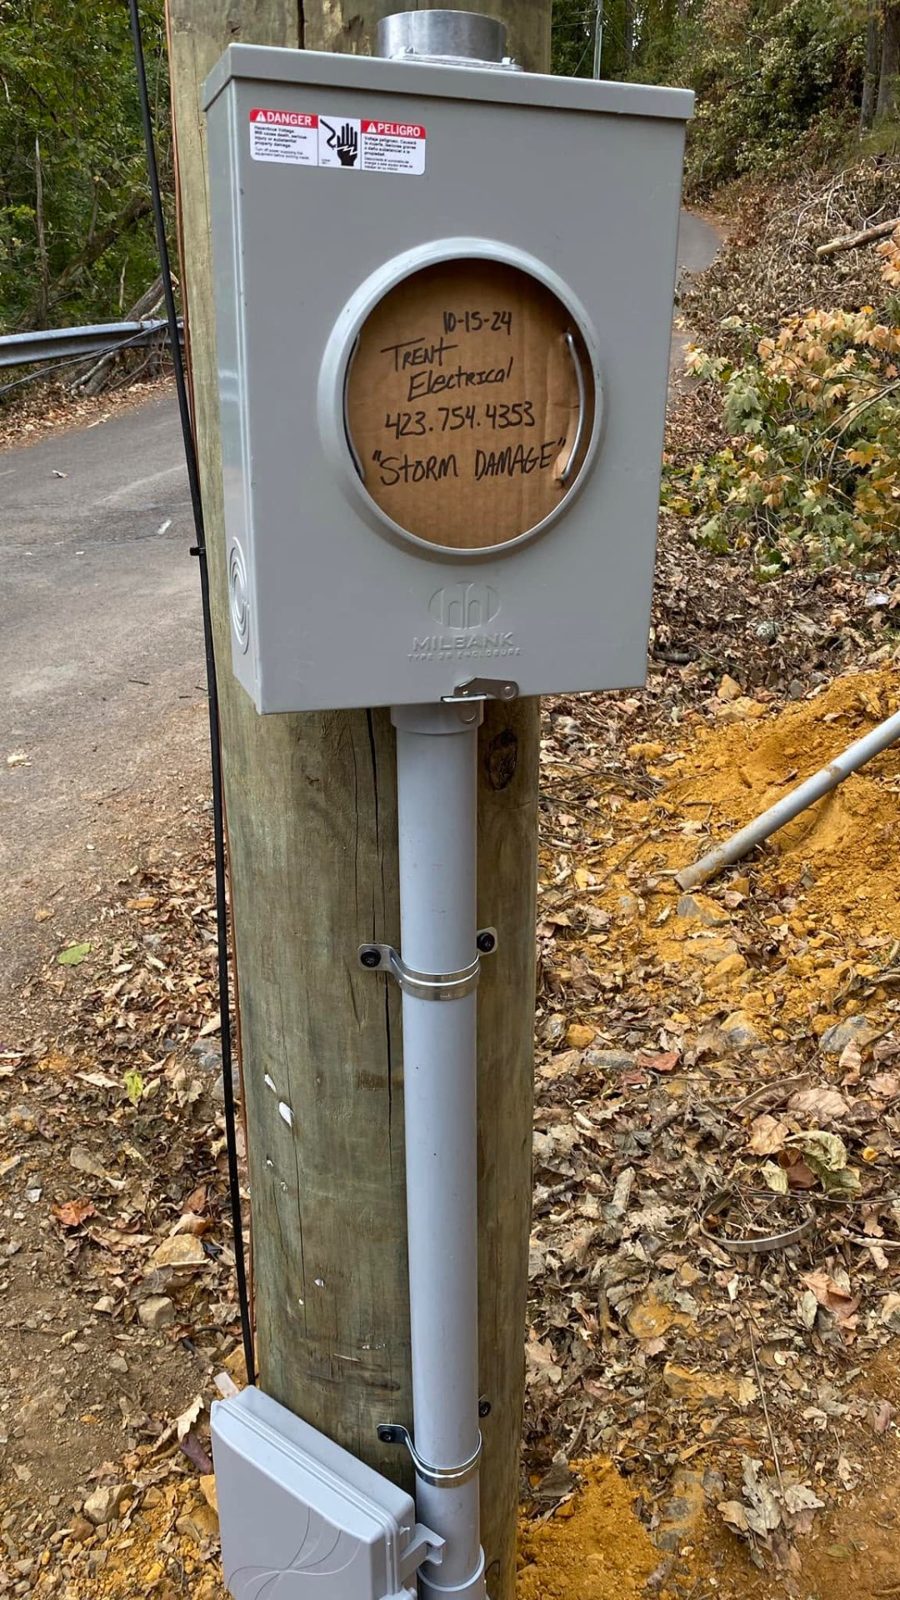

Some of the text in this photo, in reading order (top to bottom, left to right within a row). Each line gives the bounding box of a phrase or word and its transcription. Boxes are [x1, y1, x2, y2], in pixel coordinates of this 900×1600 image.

[266, 112, 312, 126] DANGER
[377, 124, 421, 136] PELIGRO
[443, 311, 512, 335] 10-15-24
[384, 402, 535, 440] 423.754.4353
[413, 632, 514, 651] MILBANK
[407, 653, 433, 663] TYPE
